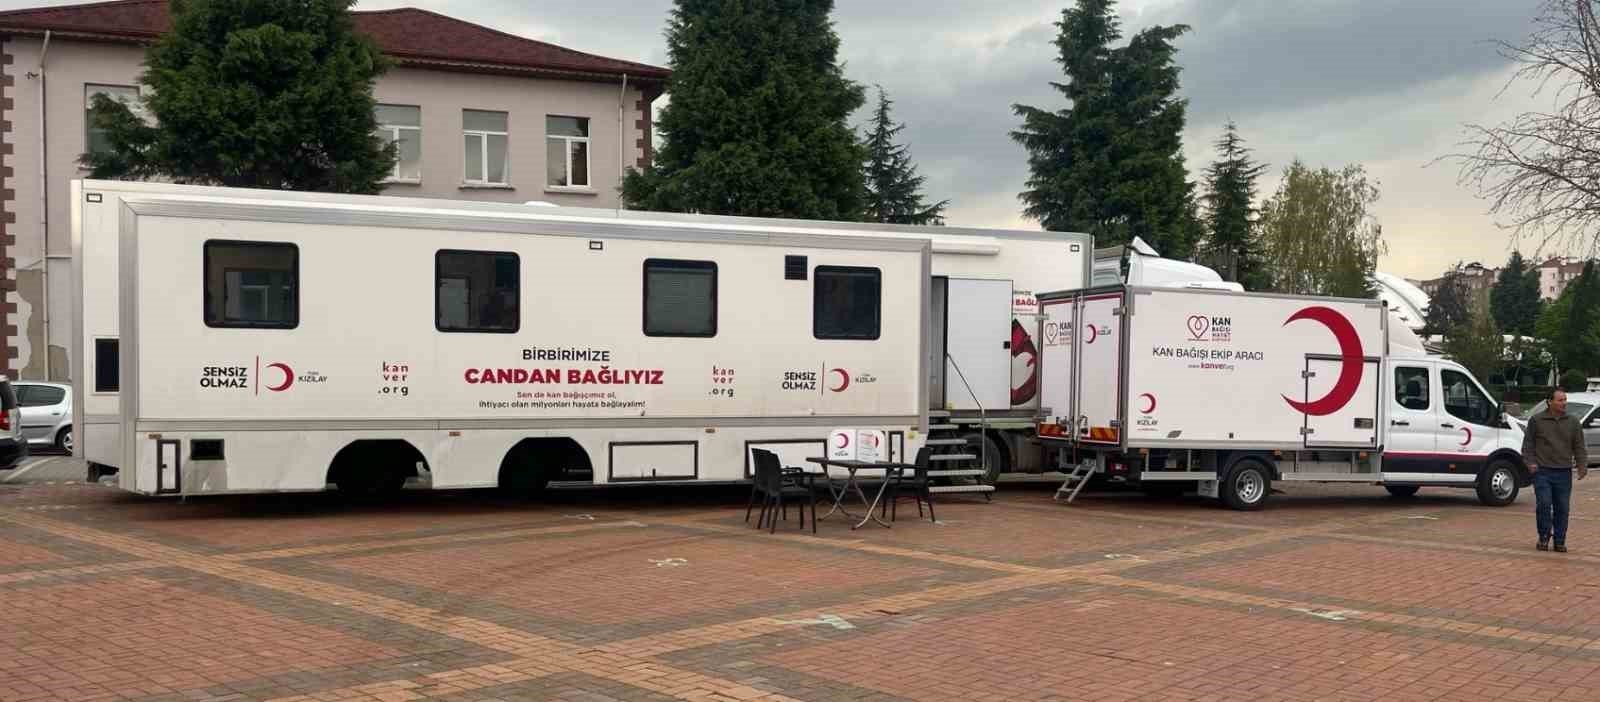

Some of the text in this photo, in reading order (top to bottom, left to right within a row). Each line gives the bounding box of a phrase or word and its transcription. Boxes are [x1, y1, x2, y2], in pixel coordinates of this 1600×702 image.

[1212, 317, 1231, 325] KAN
[522, 347, 610, 361] BİRBİRİMİZE
[1153, 347, 1264, 361] KAN BAĞIŞI EKİP ARACI
[203, 366, 248, 377] SENSİZ
[383, 361, 408, 372] kan
[713, 365, 734, 375] kan
[464, 366, 664, 385] CANDAN BAĞLIYIZ
[783, 371, 816, 380] SENSİZ
[200, 377, 248, 388] OLMAZ
[782, 381, 816, 390] OLMAZ
[378, 386, 408, 396] .org
[517, 391, 533, 399] Sen
[534, 391, 545, 399] de
[546, 391, 561, 399] kan
[708, 388, 734, 397] .org
[511, 400, 529, 409] olan
[531, 400, 571, 410] milyonları
[572, 400, 599, 410] hayata
[600, 400, 646, 410] bağlayalım!
